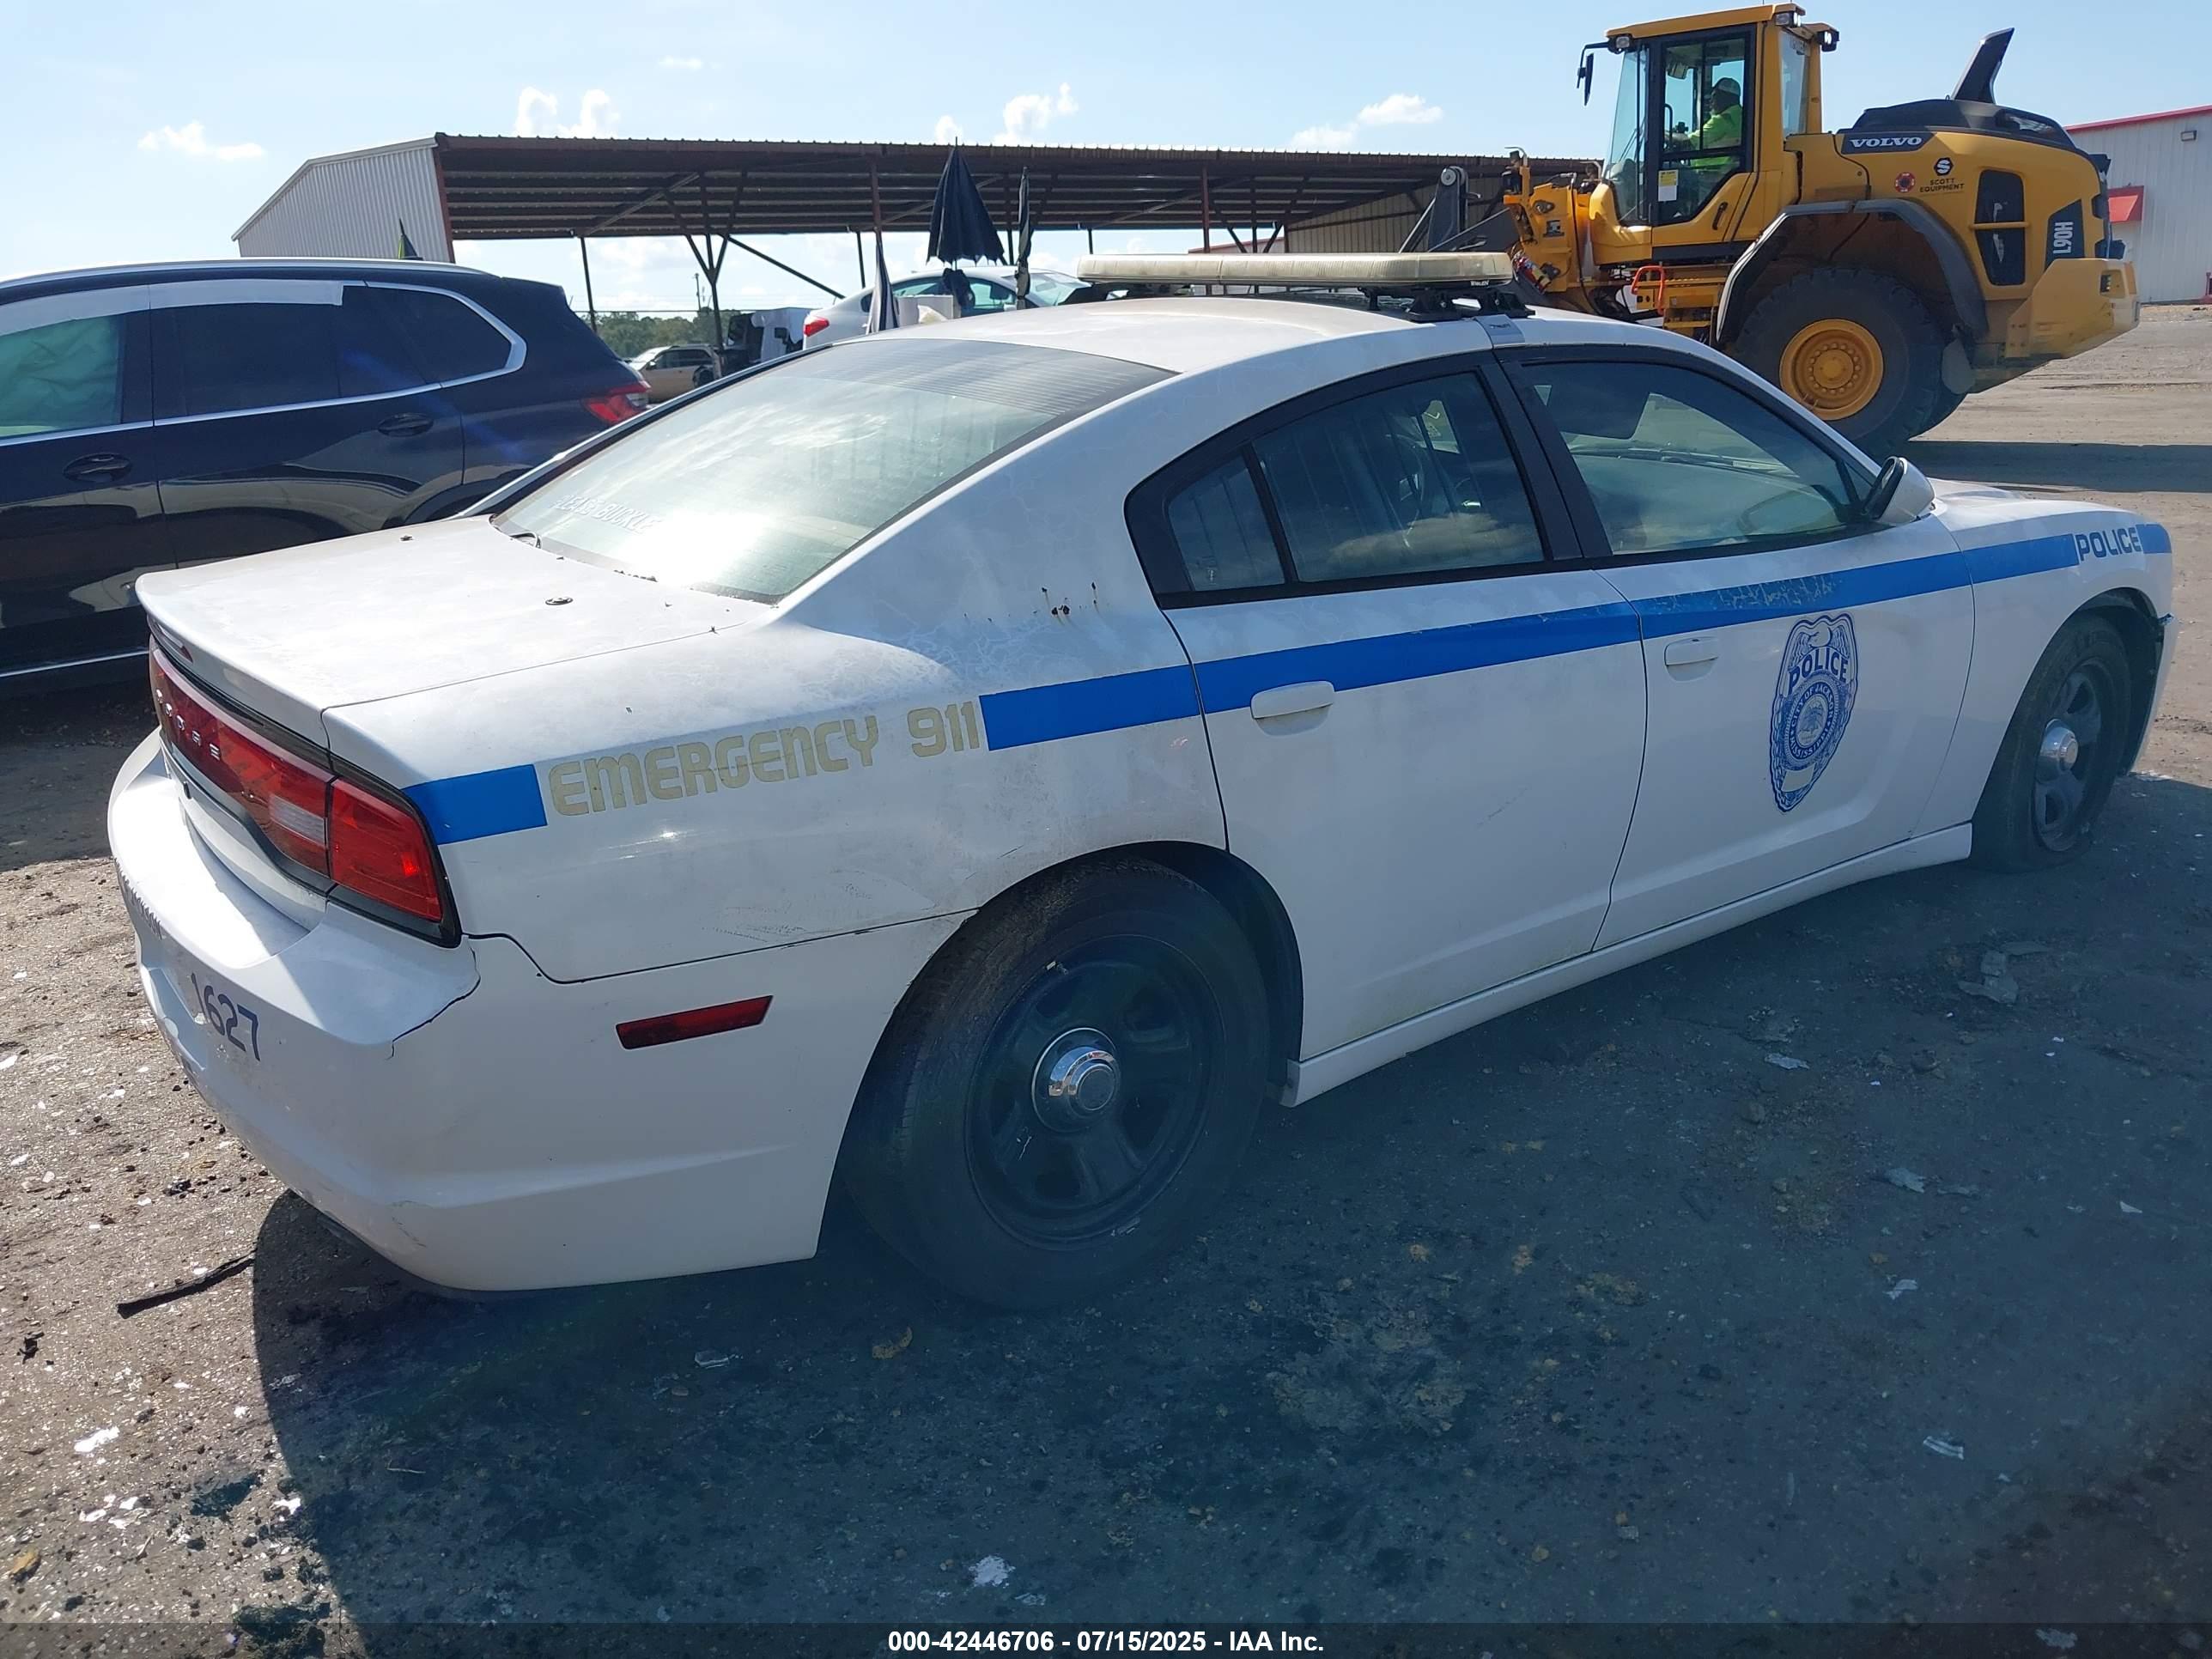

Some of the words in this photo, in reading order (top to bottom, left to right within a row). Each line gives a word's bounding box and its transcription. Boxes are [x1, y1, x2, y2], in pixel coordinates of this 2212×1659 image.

[1850, 137, 1922, 148] VOLVO
[1919, 183, 1965, 192] EQUIPMENT
[2052, 222, 2074, 254] L90H
[2075, 526, 2142, 562] POLICE
[1788, 647, 1849, 696] POLICE
[1790, 700, 1804, 727] CITY
[1804, 688, 1814, 699] OF
[1814, 684, 1834, 718] JACKSON
[548, 714, 878, 816] EMERGENCY
[907, 700, 981, 757] 911
[1790, 727, 1828, 759] MISSISSIPPI
